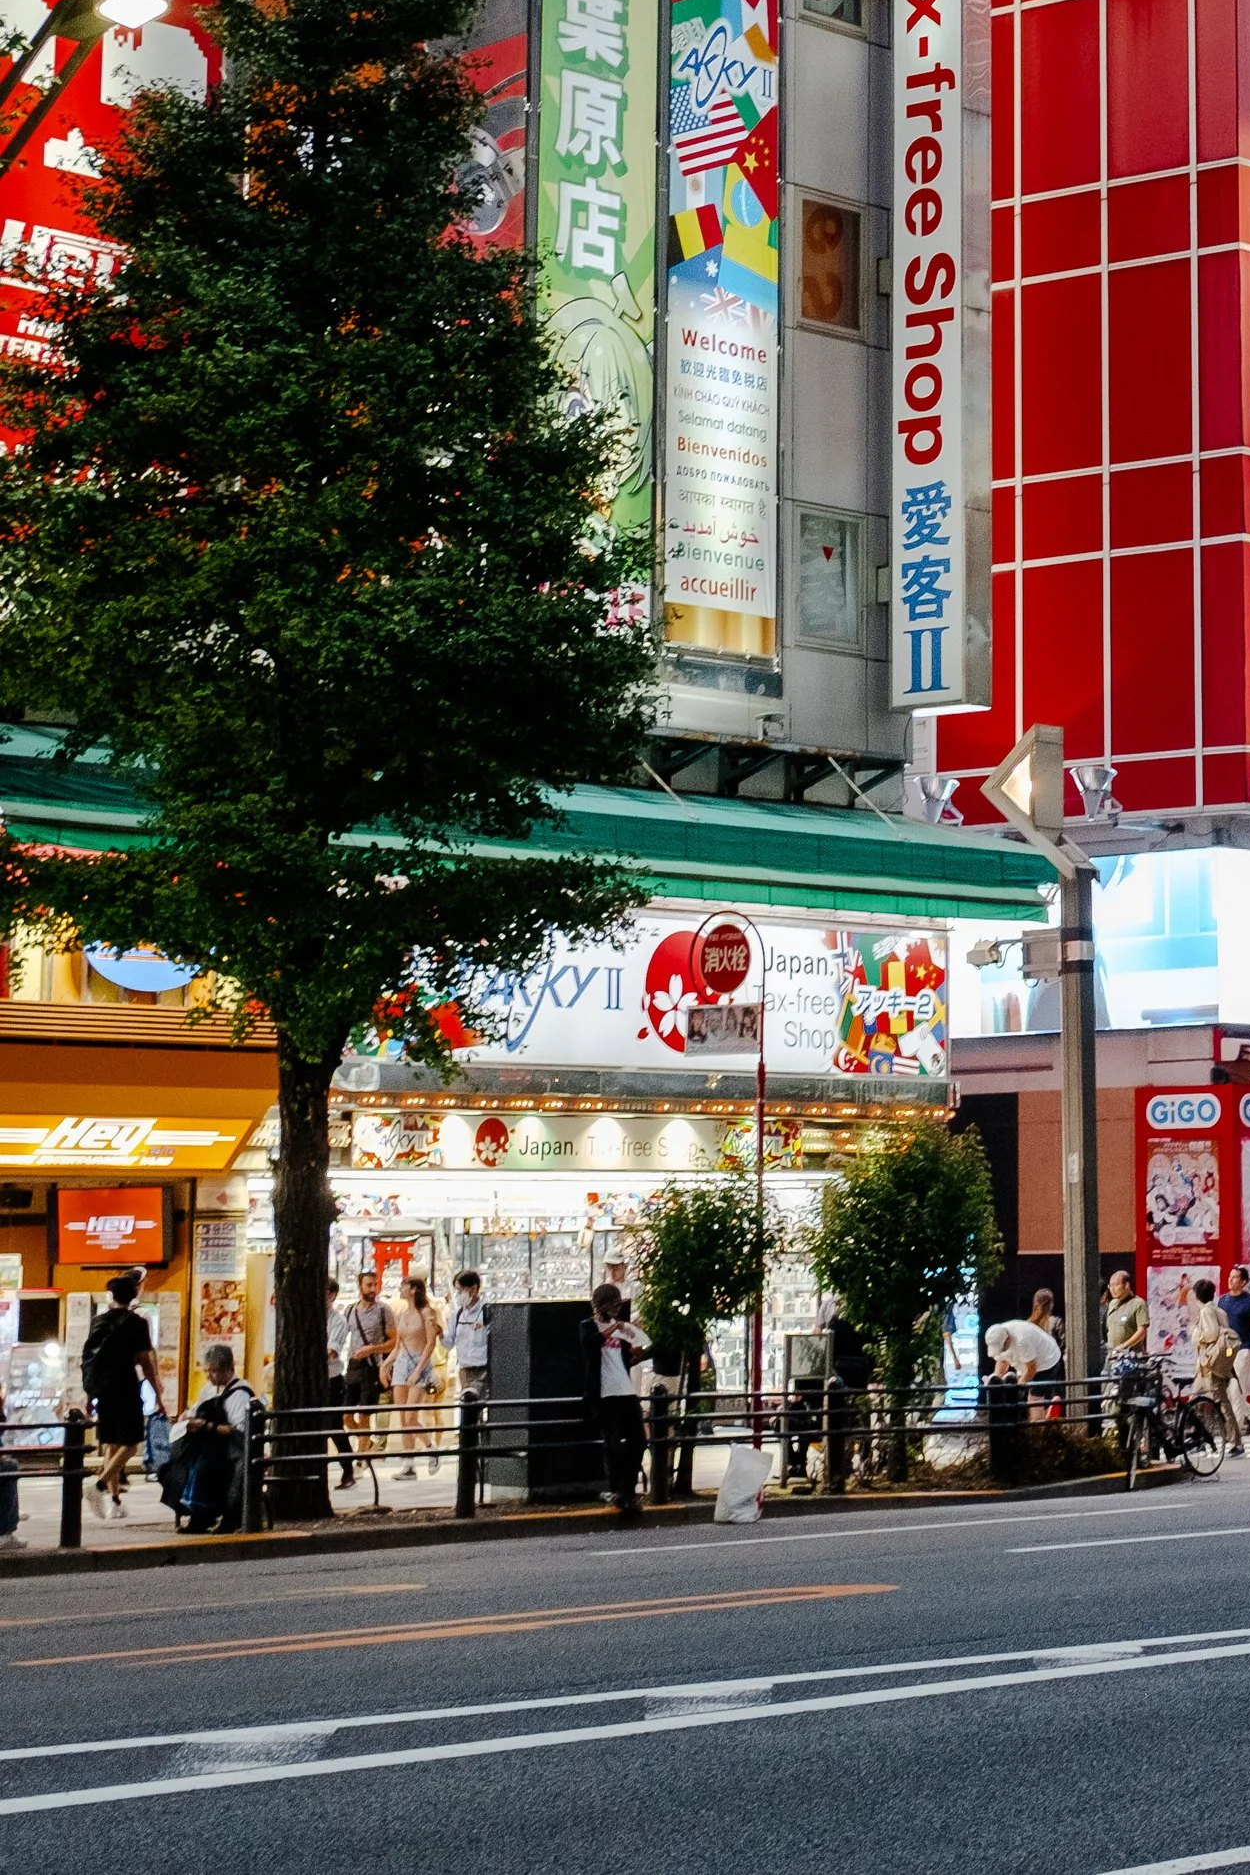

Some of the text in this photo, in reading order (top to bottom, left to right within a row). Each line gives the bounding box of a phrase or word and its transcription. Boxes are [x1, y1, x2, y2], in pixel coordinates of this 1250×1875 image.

[682, 328, 768, 364] Welcome
[898, 251, 957, 467] Shop
[678, 409, 768, 443] Selamat datang
[677, 436, 768, 468] Bienvenidos
[678, 541, 765, 572] Bienvenue
[680, 575, 757, 602] accueillir
[704, 944, 748, 973] 消火栓
[752, 984, 835, 1017] Tax-free
[853, 987, 936, 1025] アッキー2
[783, 1021, 836, 1055] Shop
[1150, 1100, 1217, 1124] GiGO
